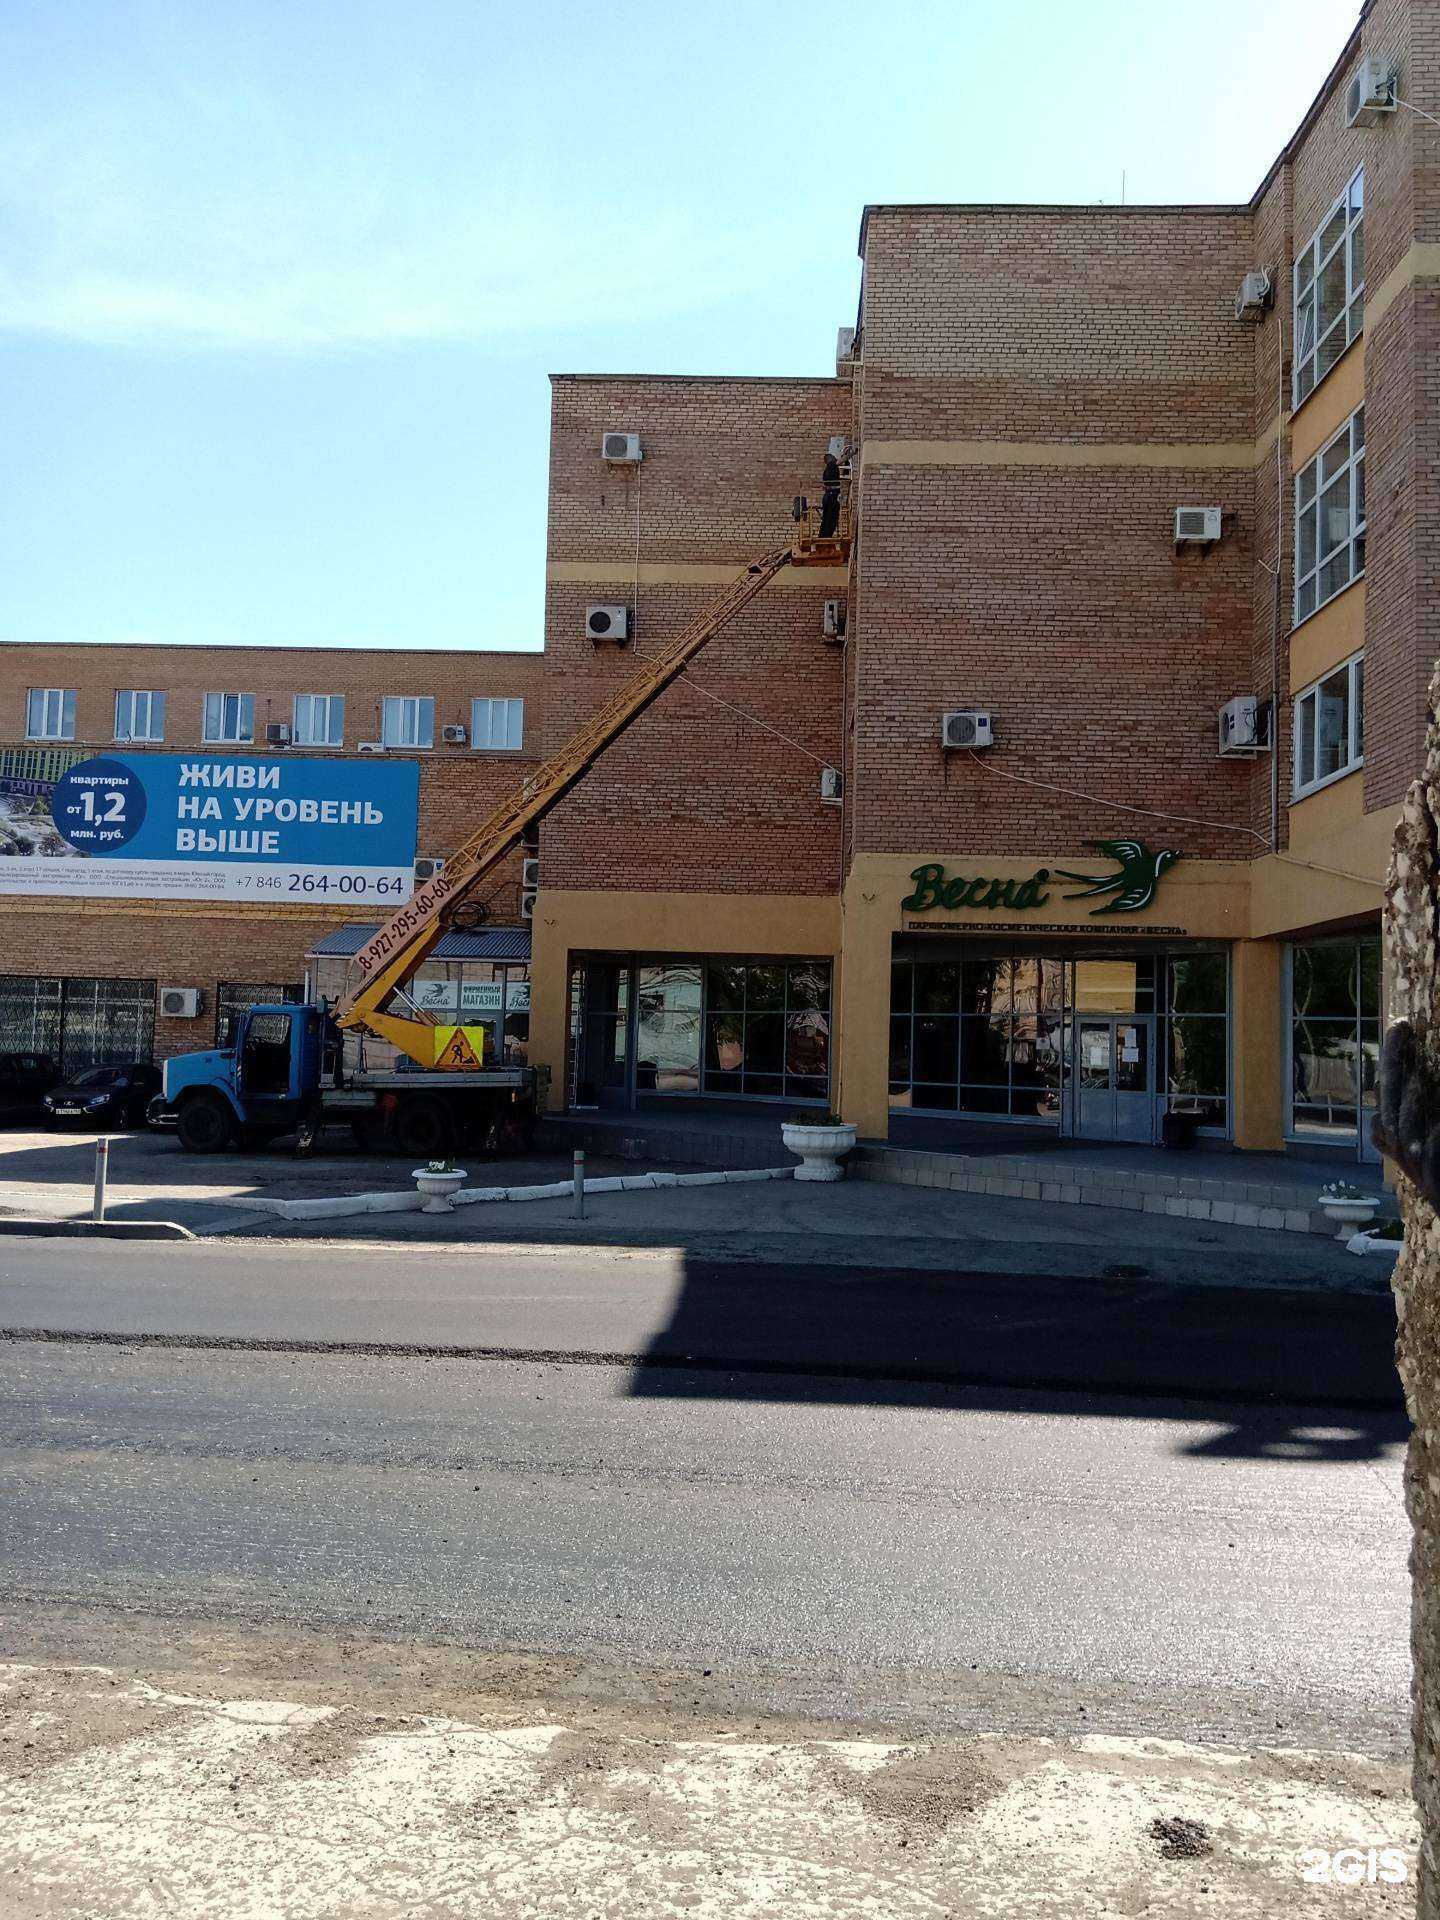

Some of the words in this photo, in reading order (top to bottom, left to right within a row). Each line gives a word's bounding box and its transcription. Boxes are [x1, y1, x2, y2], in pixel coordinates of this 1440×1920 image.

[70, 776, 129, 787] квартиры
[178, 764, 280, 789] ЖИВИ
[66, 805, 82, 814] от
[80, 791, 126, 827] 1,2
[177, 796, 222, 820] НА
[233, 797, 384, 825] УРОВЕНЬ
[70, 830, 97, 839] млн.
[99, 829, 124, 841] руб.
[176, 828, 280, 854] ВЫШЕ
[235, 877, 252, 888] +7
[256, 876, 282, 889] 846
[288, 873, 404, 895] 264-00-64
[901, 863, 1050, 911] Весна
[358, 878, 451, 970] 8-927-295-60-60
[461, 995, 501, 1007] МАГАЗИН
